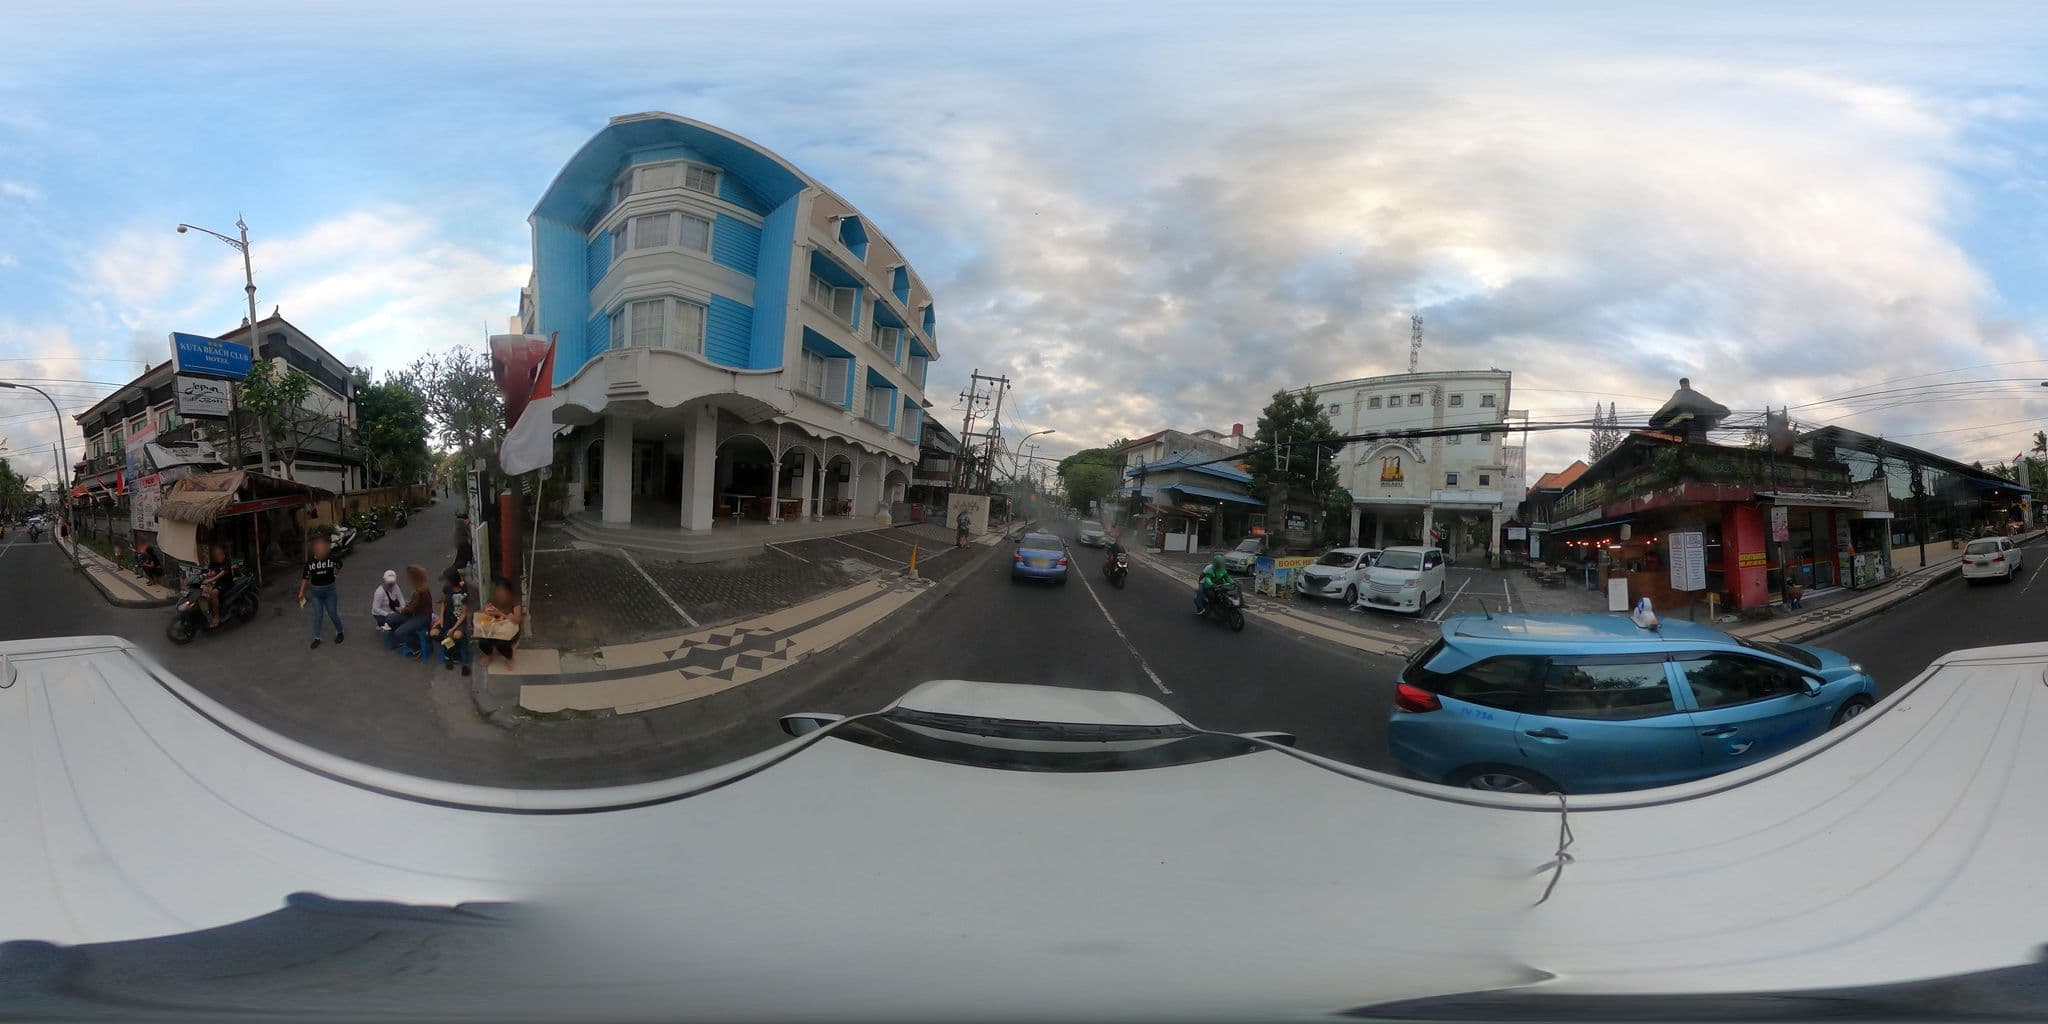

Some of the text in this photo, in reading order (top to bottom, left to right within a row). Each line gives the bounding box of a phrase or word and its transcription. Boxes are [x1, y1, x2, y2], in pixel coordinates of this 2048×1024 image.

[180, 343, 249, 361] KUTA BEACH CLUB
[205, 355, 229, 364] HOTEL
[1278, 559, 1300, 567] BOOK
